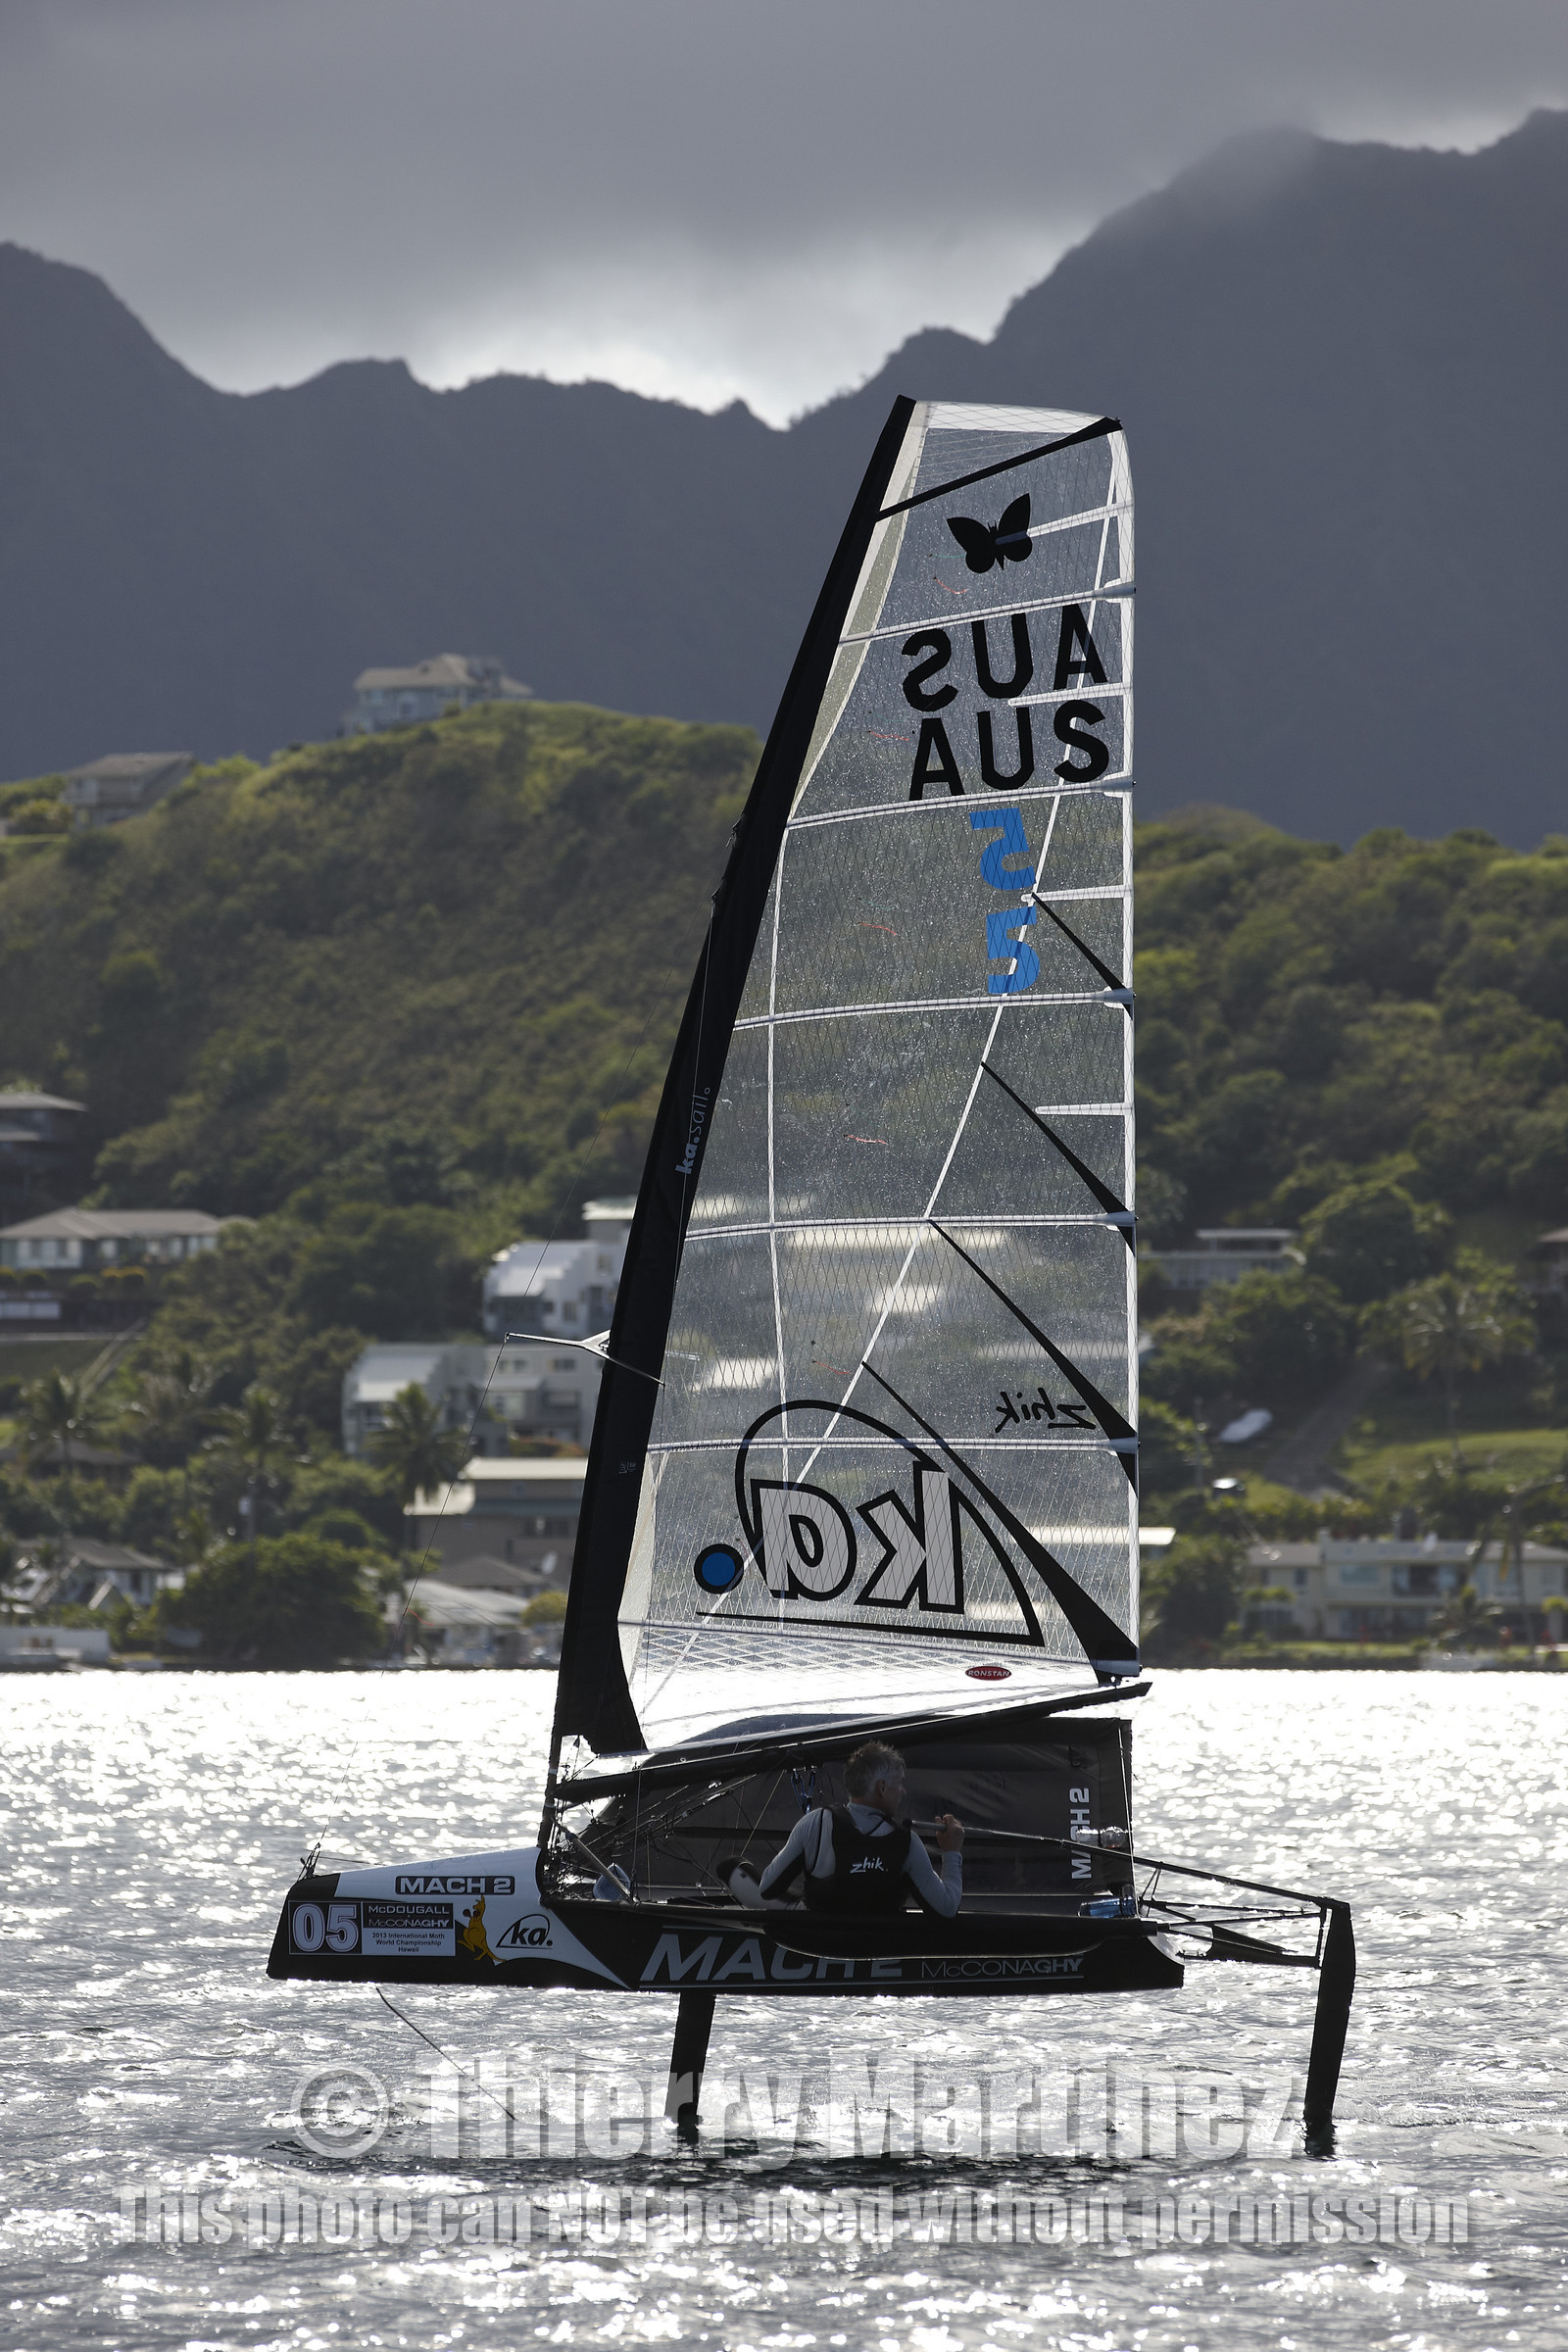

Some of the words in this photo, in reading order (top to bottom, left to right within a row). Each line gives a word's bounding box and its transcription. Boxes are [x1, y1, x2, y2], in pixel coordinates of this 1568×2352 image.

[908, 700, 1109, 801] AUS
[986, 905, 1040, 995] 5
[967, 1669, 1010, 1678] RONSTAN
[1069, 1788, 1090, 1803] 2
[850, 1857, 884, 1873] zhik
[400, 1878, 486, 1893] MACH
[493, 1878, 511, 1893] 2
[368, 1905, 450, 1914] McDOUGALL
[292, 1903, 359, 1953] 05
[368, 1919, 450, 1928] McCONAGHY
[921, 1958, 1084, 1978] McCONAGHY
